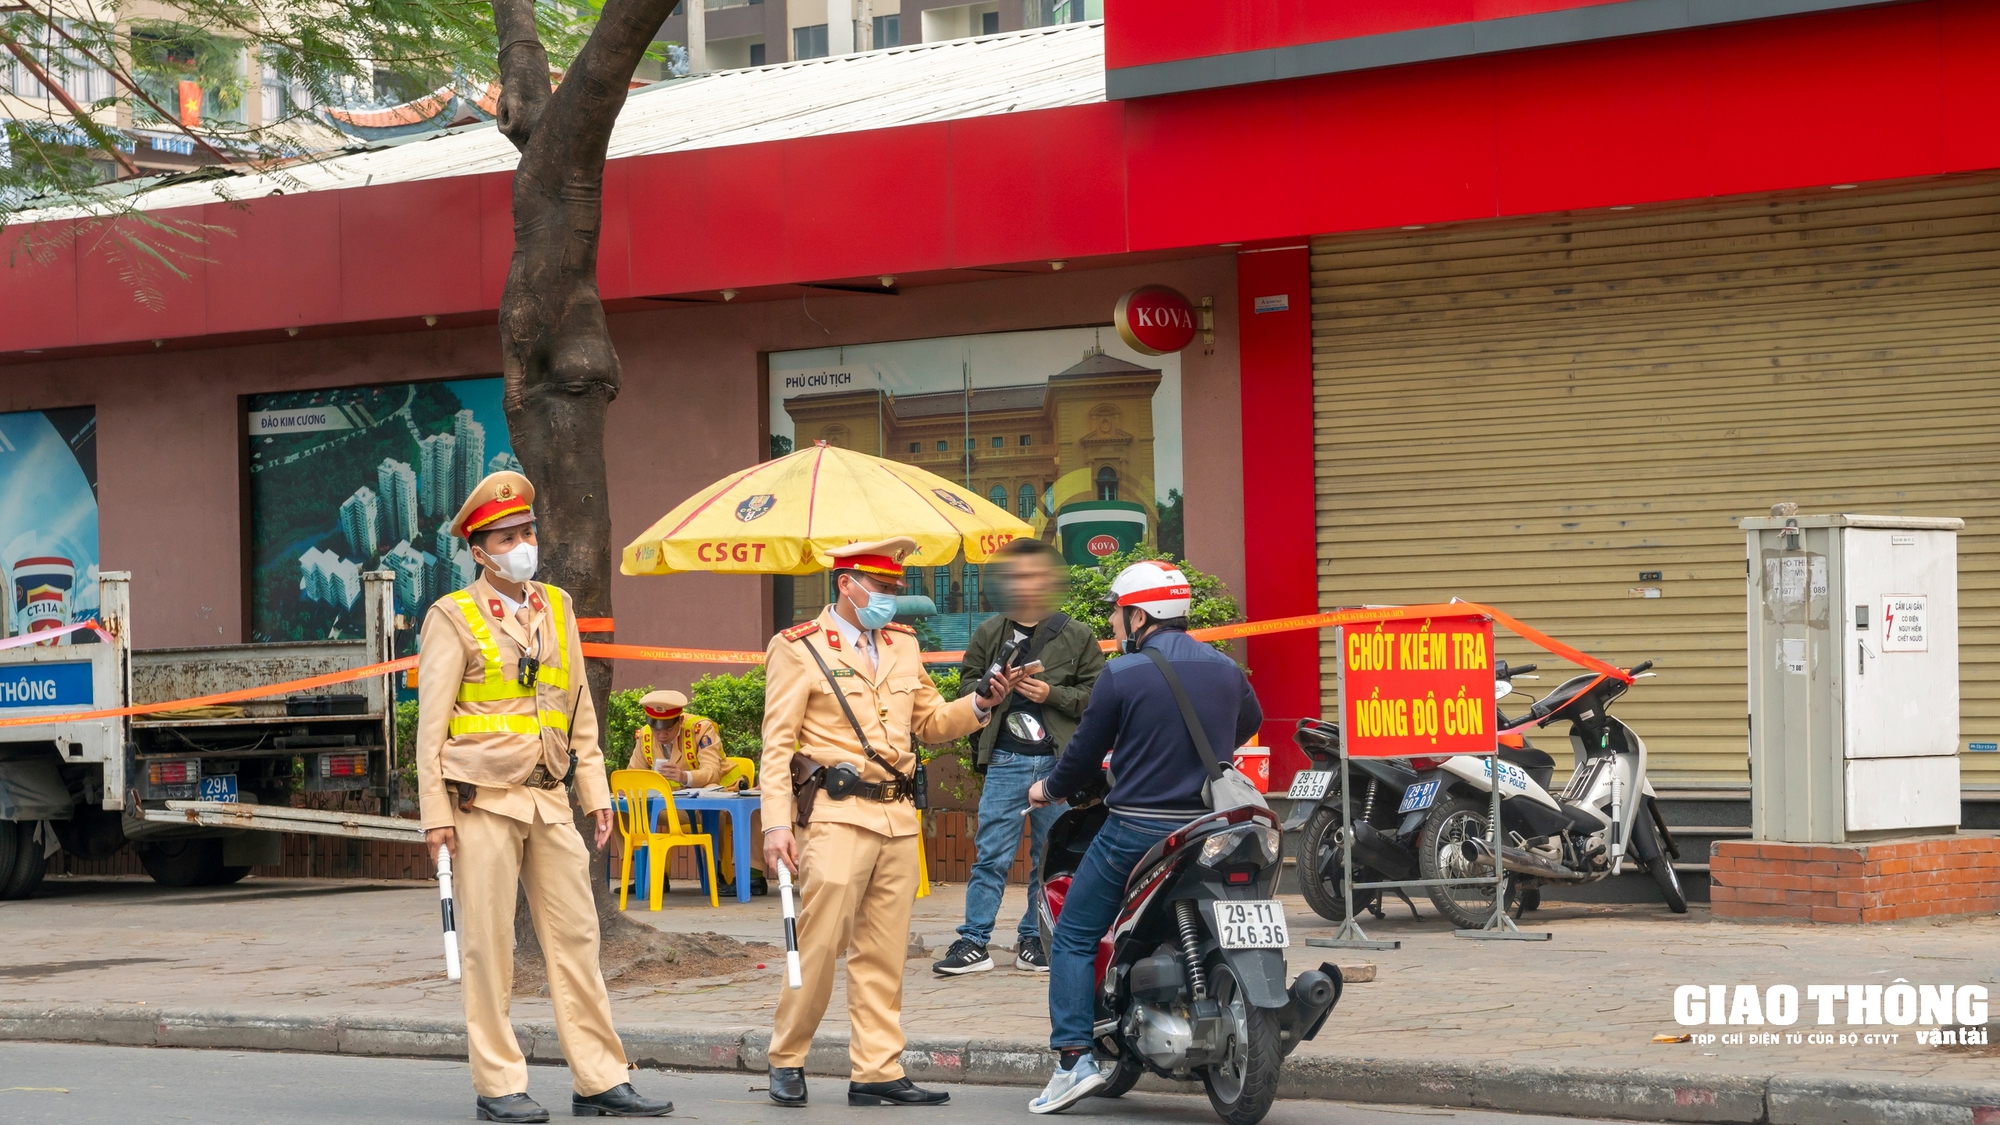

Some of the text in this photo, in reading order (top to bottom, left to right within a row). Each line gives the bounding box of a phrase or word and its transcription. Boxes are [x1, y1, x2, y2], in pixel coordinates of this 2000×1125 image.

[1136, 307, 1192, 329] KOVA
[785, 371, 851, 388] PHỦ CHỦ TỊCH
[261, 413, 326, 428] ĐẢO KIM CƯƠNG
[697, 542, 766, 563] CSGT
[1091, 541, 1116, 551] KOVA
[27, 602, 58, 617] CT-11A
[1262, 621, 1283, 631] GIAO
[1284, 618, 1305, 629] TOÀN
[1306, 617, 1316, 625] AN
[1233, 624, 1262, 636] THÔNG
[1348, 617, 1487, 671] CHỐT KIỂM TRA
[640, 649, 668, 660] THÔNG
[1356, 685, 1483, 744] NỒNG ĐỘ CỒN
[684, 729, 698, 770] CSGT
[1297, 772, 1326, 784] 29-L1
[1508, 777, 1527, 790] POLICE
[206, 777, 229, 795] 29A
[1289, 784, 1324, 797] 839.59
[1408, 782, 1435, 798] 29-B1
[1225, 904, 1274, 924] 29-T1
[1223, 925, 1284, 945] 246.36
